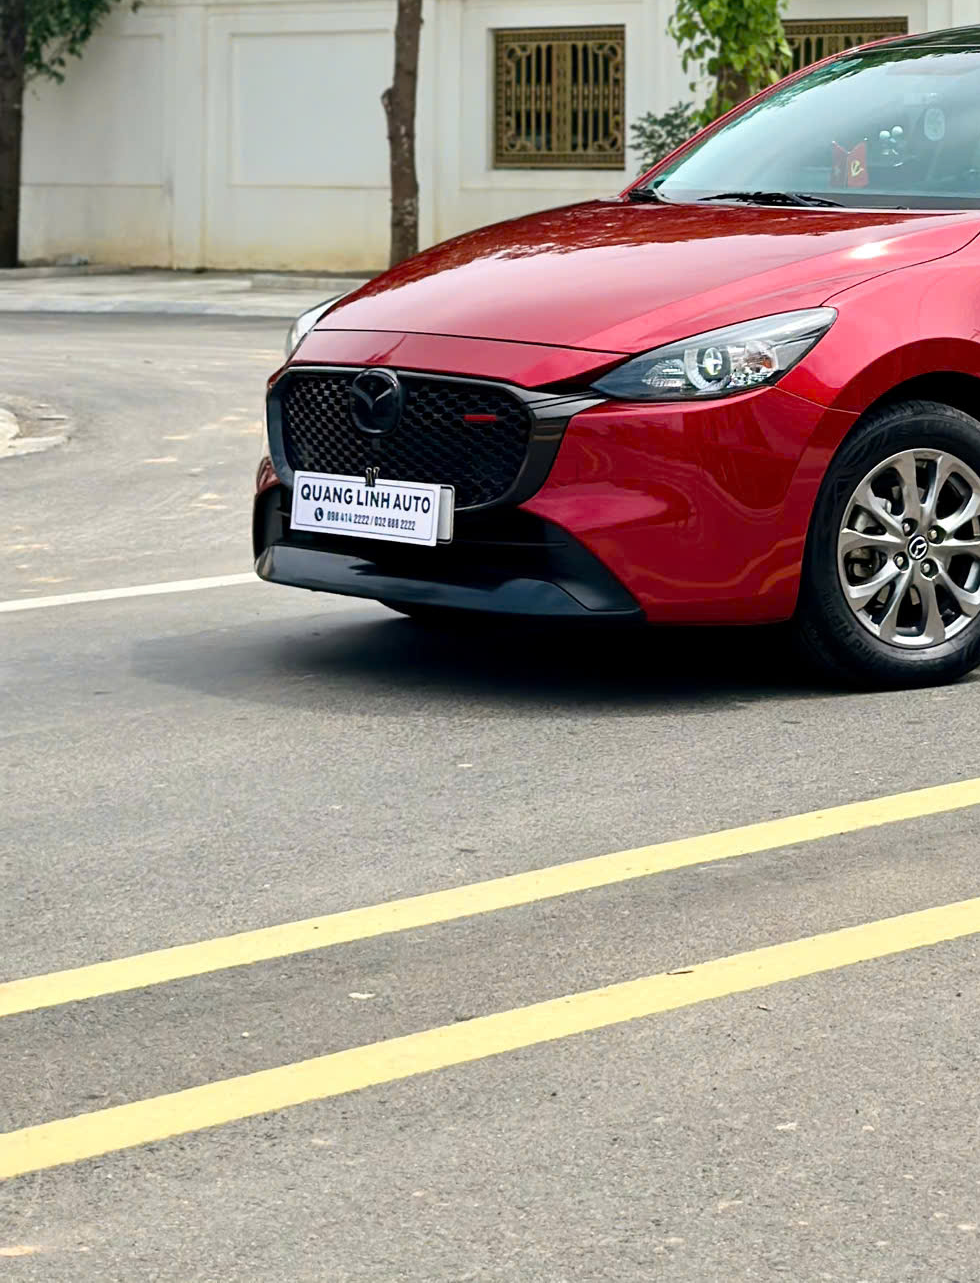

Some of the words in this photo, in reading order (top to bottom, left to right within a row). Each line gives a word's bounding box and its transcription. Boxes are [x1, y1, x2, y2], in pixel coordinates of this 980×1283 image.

[301, 484, 353, 505] QUANG
[356, 489, 390, 509] LINH
[393, 494, 431, 514] AUTO
[353, 514, 370, 526] 2222
[400, 520, 416, 531] 2222
